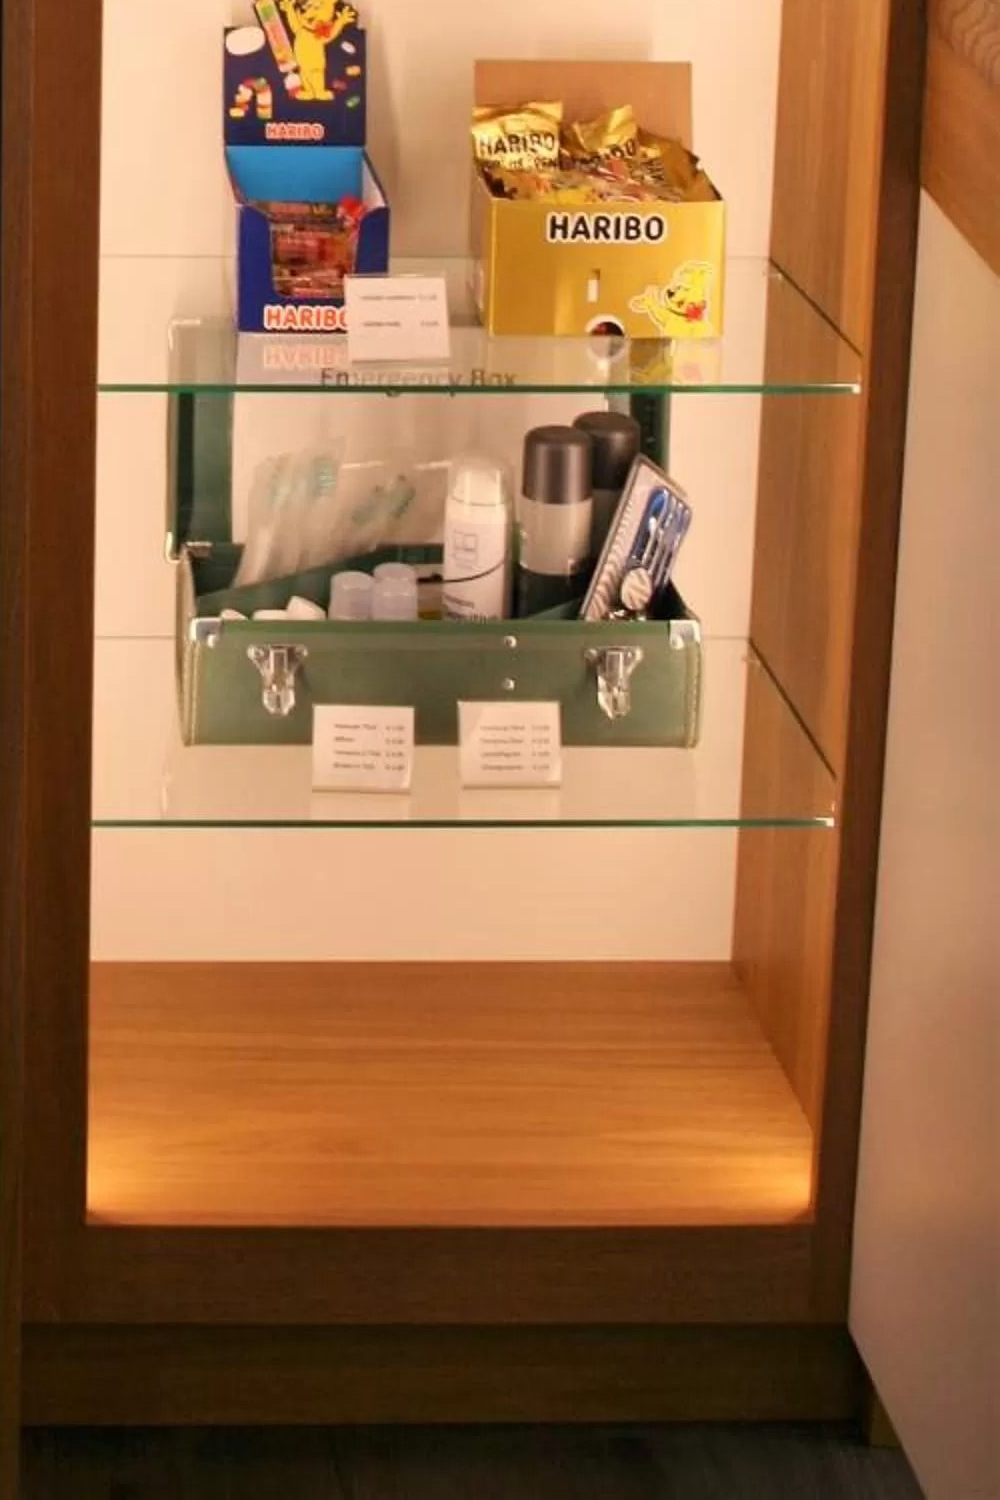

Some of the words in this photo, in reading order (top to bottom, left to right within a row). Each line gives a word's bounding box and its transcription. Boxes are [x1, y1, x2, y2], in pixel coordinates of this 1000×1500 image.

[266, 123, 324, 140] HARIBO
[478, 131, 556, 155] HARIBO
[549, 215, 665, 241] HARIBO
[320, 367, 464, 397] Emergency
[471, 368, 518, 387] Box
